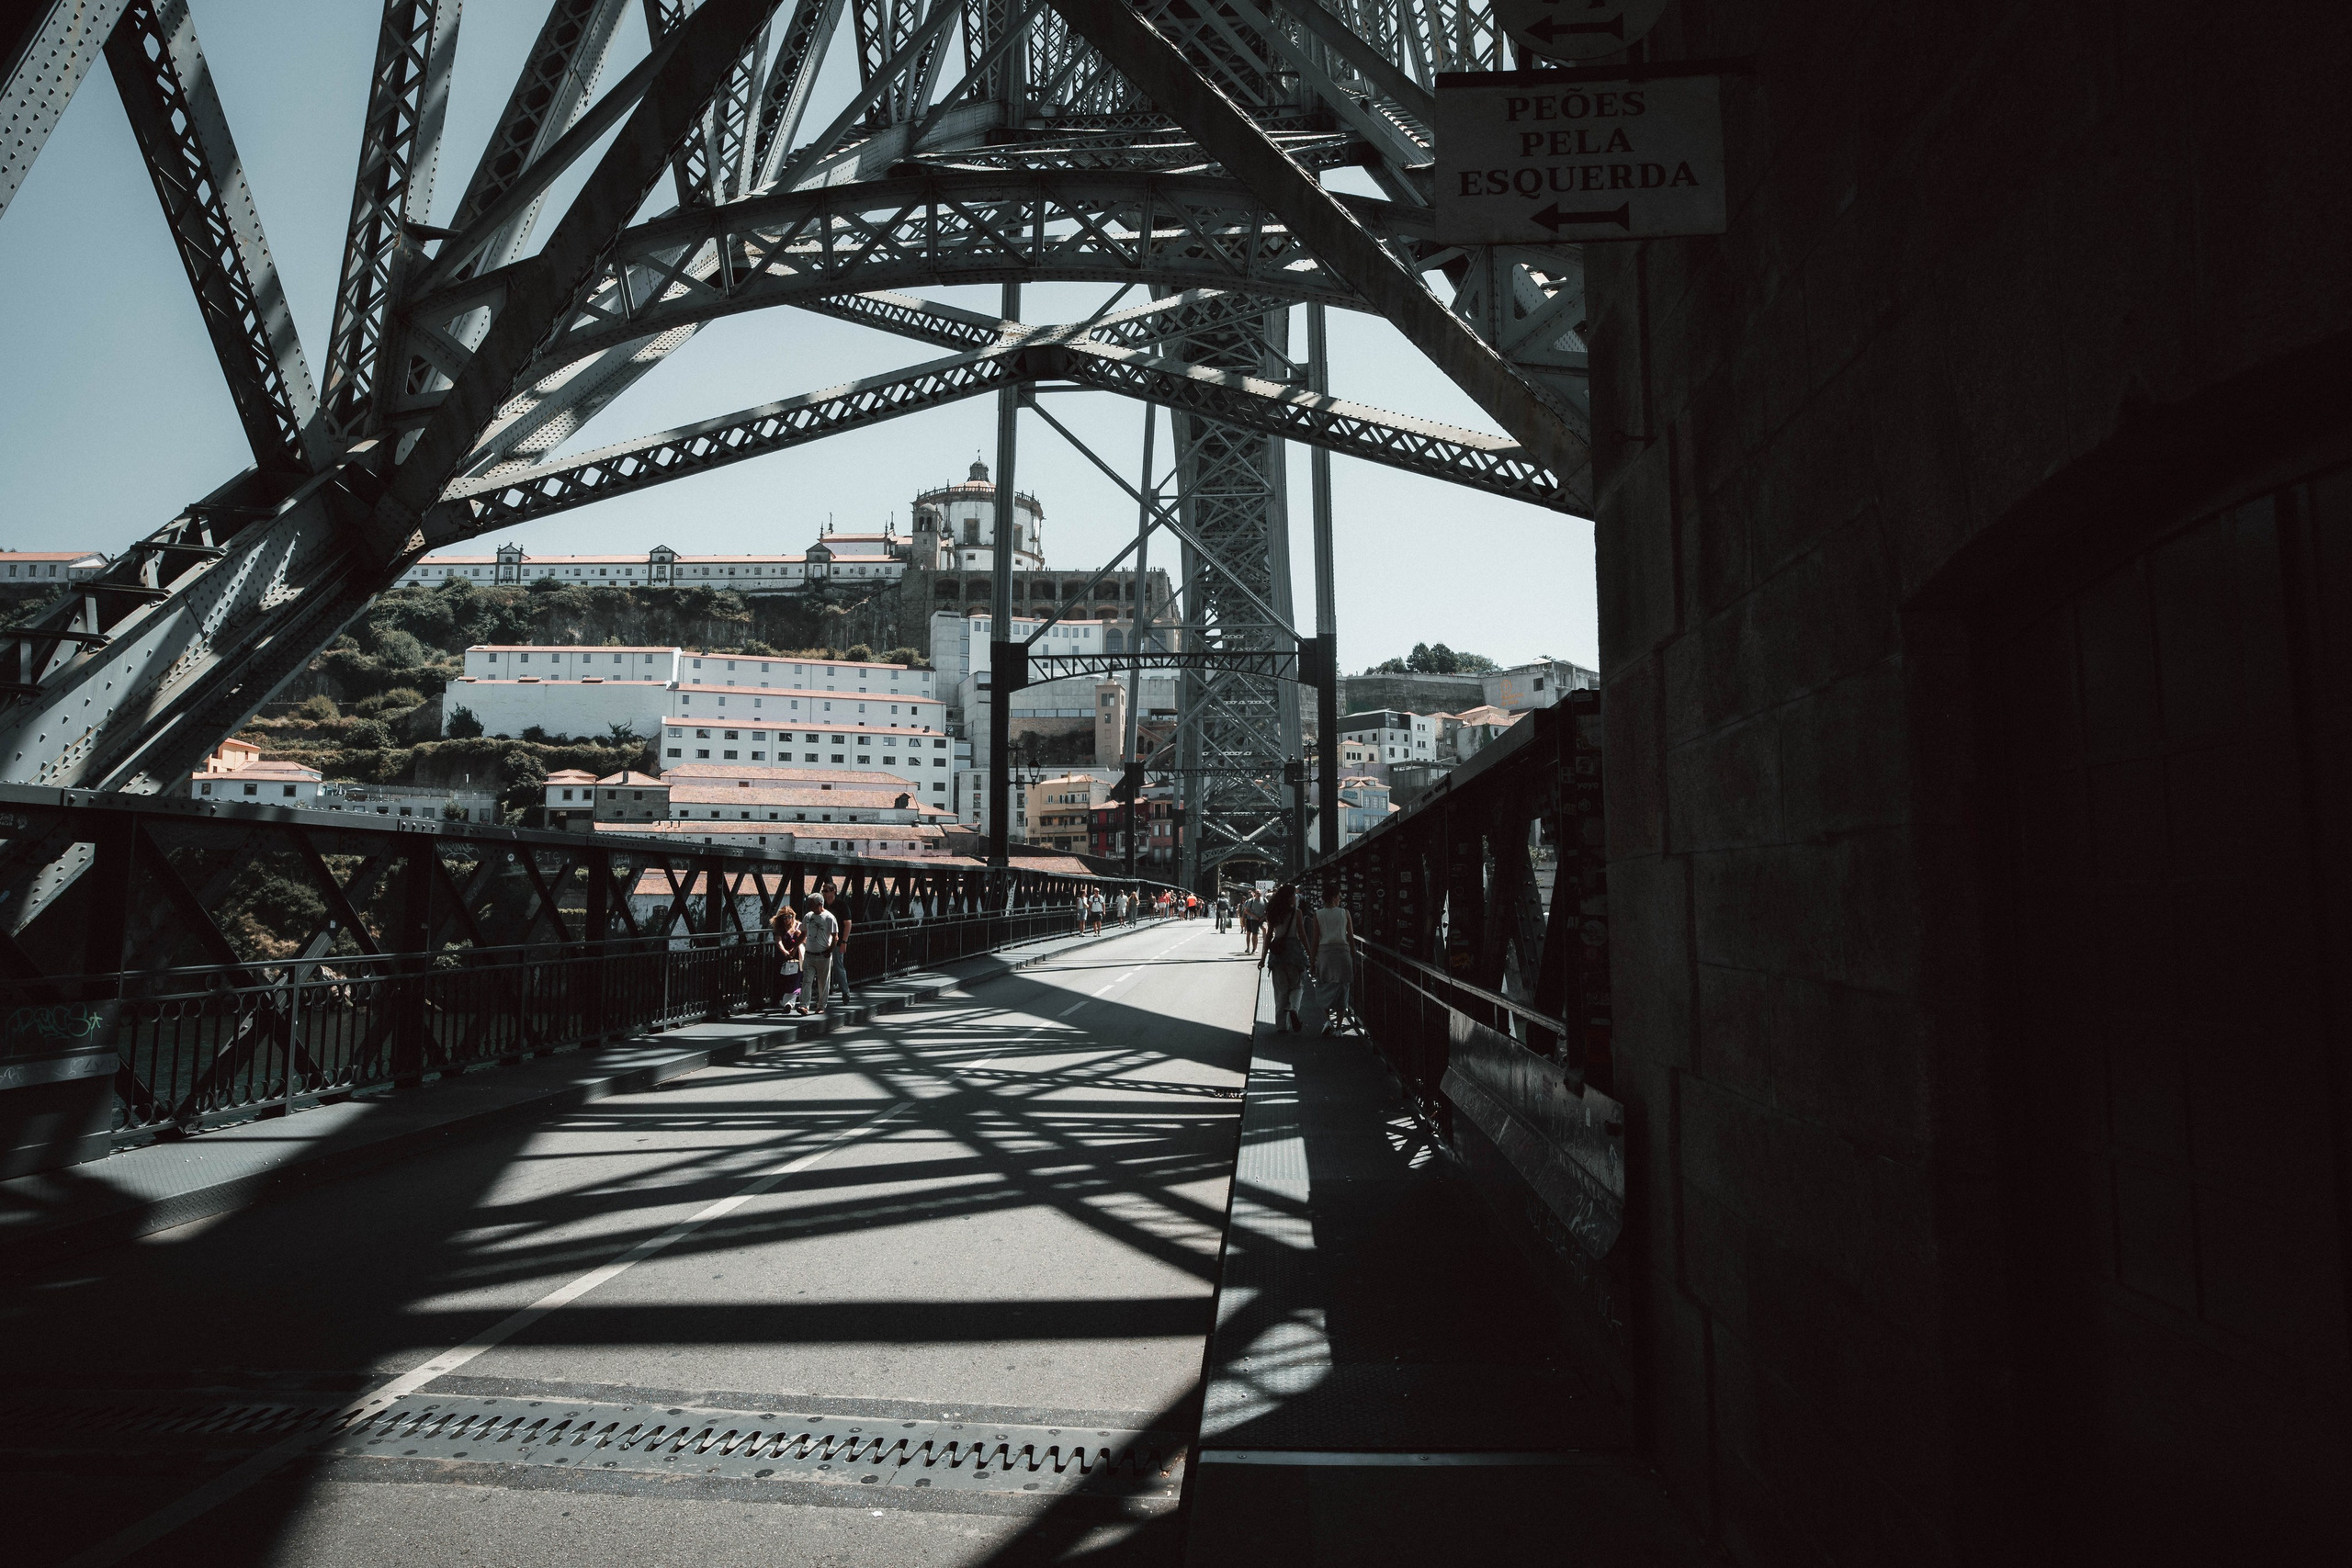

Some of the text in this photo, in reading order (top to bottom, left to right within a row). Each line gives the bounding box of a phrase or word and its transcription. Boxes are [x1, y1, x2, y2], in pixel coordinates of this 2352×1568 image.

[1505, 87, 1646, 122] PEÕES
[1519, 127, 1634, 157] PELA
[1458, 161, 1700, 200] ESQUERDA
